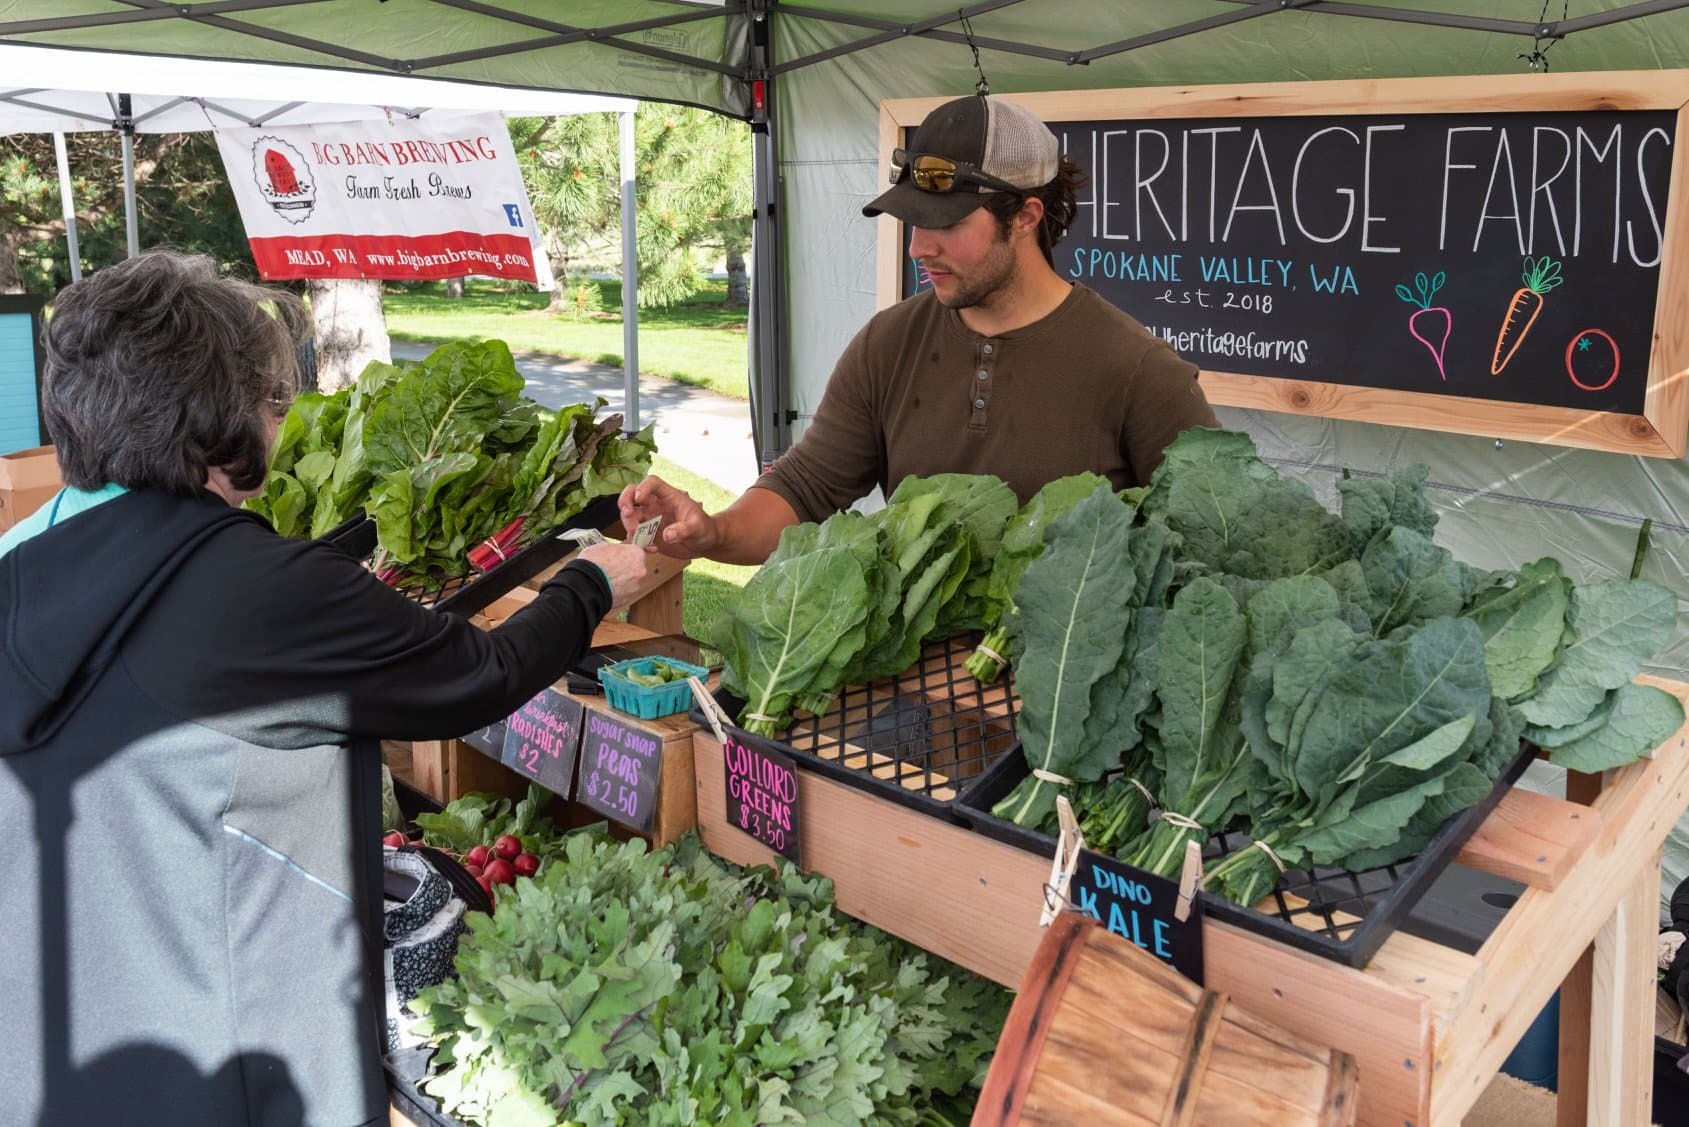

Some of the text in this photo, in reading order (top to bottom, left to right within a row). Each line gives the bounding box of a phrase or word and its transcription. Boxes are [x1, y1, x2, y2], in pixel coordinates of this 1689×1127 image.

[390, 136, 497, 166] BREWING
[346, 172, 472, 200] Farm Fresh Brews
[1063, 122, 1671, 268] HERITAGE FARMS
[285, 248, 530, 270] MEAD, WA www.bigbarnbrewing.com
[1069, 247, 1358, 296] SPOKANE VALLEY, WA
[1222, 292, 1273, 314] 2018
[511, 711, 563, 759] RADISHES
[520, 742, 539, 774] $2
[587, 770, 637, 817] $2.50
[725, 739, 796, 803] COLLARD
[729, 774, 791, 831] GREENS
[740, 803, 784, 850] $3.50
[1092, 864, 1152, 905] DINO
[1080, 886, 1172, 958] KALE
